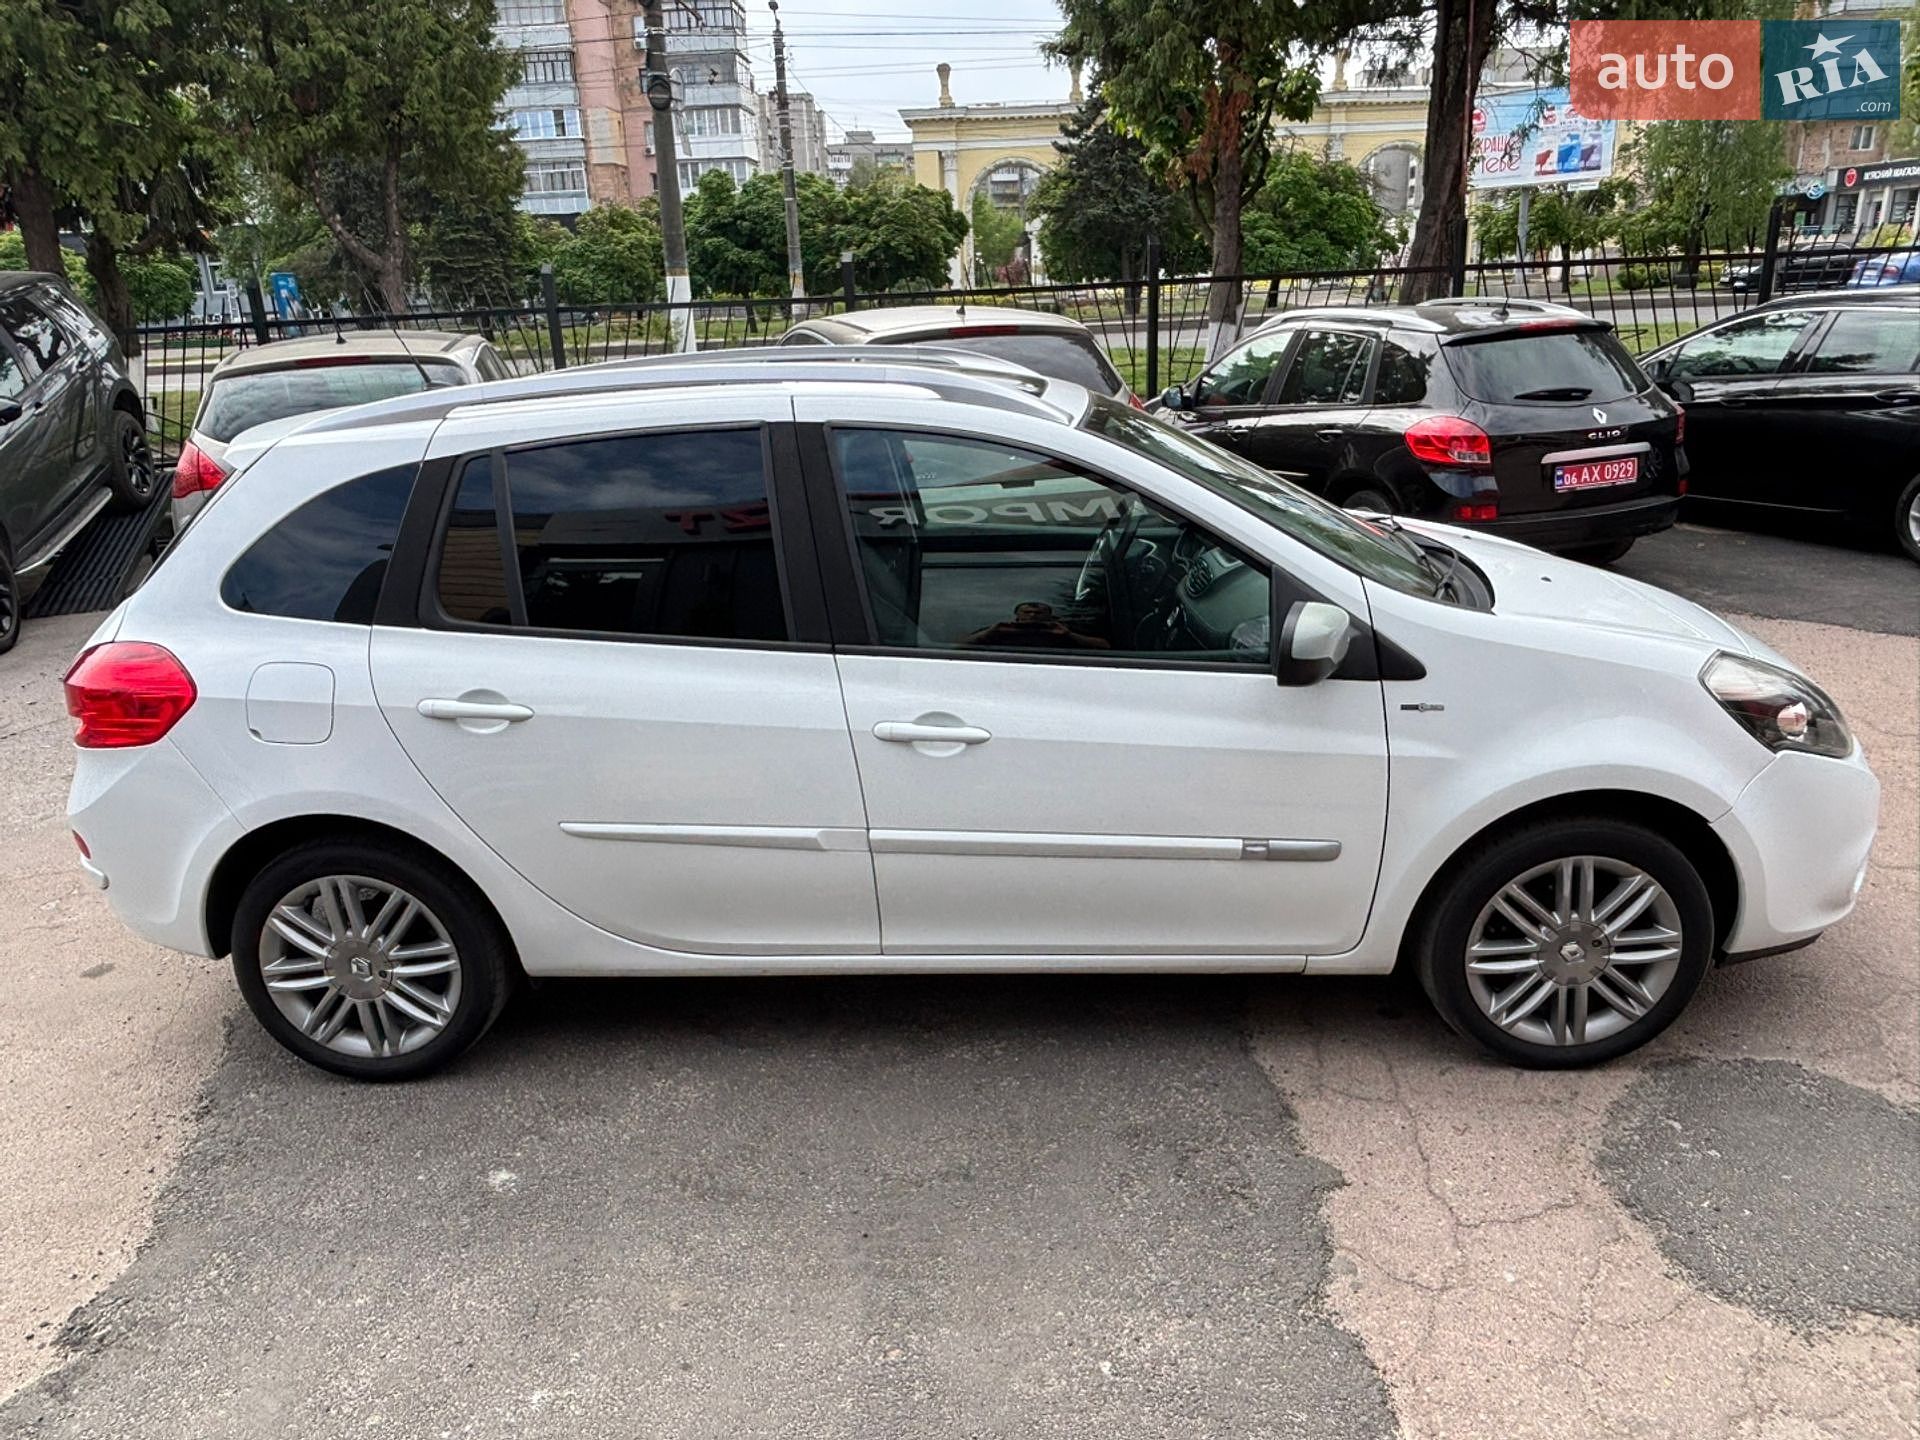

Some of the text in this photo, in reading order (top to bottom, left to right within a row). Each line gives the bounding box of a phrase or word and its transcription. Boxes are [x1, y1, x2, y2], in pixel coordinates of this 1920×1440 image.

[1587, 429, 1621, 440] CLIO
[1563, 460, 1634, 485] 06 AX 0929
